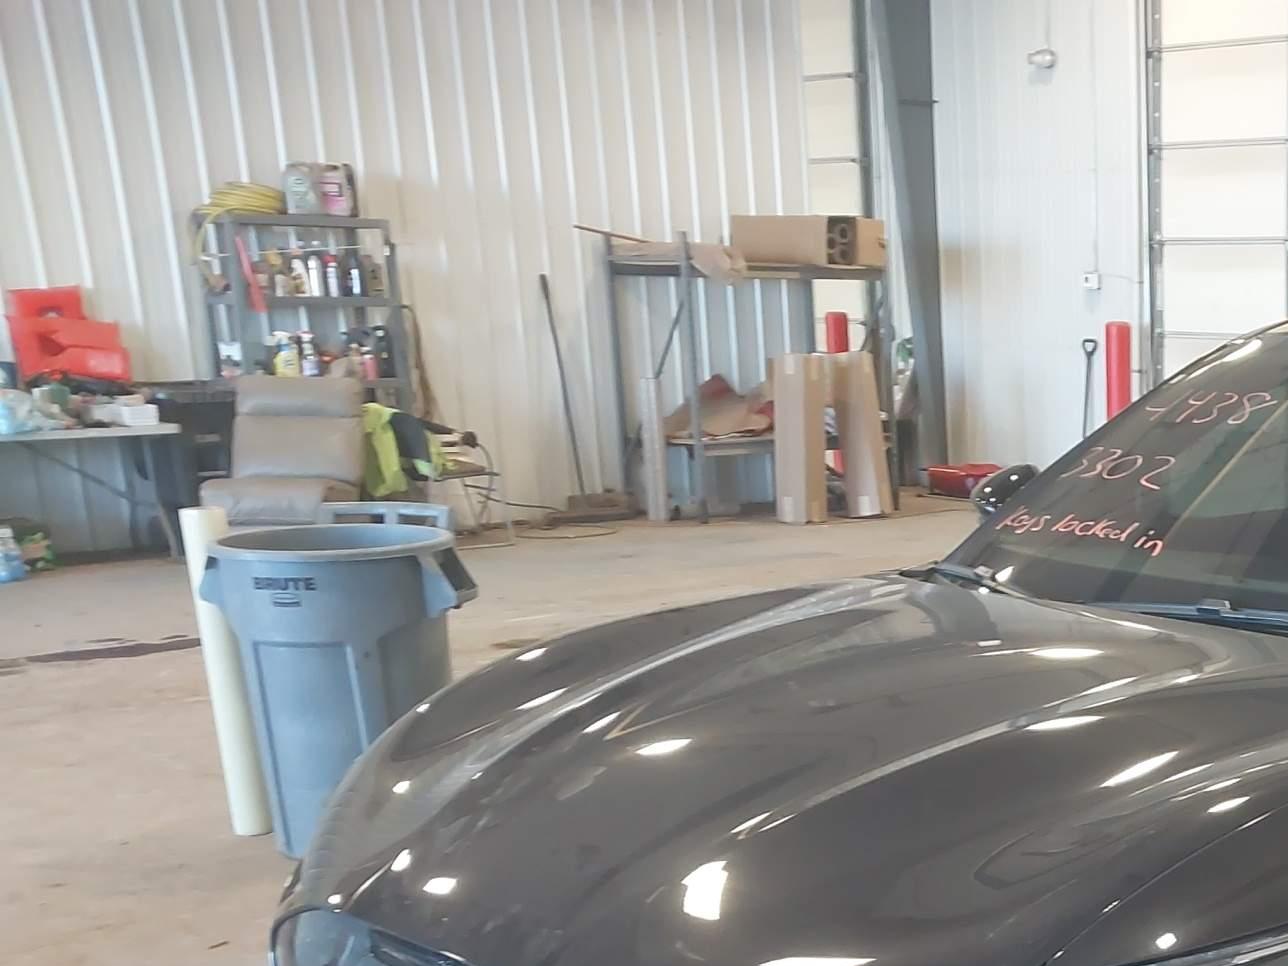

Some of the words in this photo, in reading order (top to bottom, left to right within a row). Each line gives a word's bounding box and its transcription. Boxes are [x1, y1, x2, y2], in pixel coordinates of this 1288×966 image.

[1058, 446, 1177, 491] 3302
[1133, 530, 1164, 557] in
[252, 576, 317, 592] BRUTE
